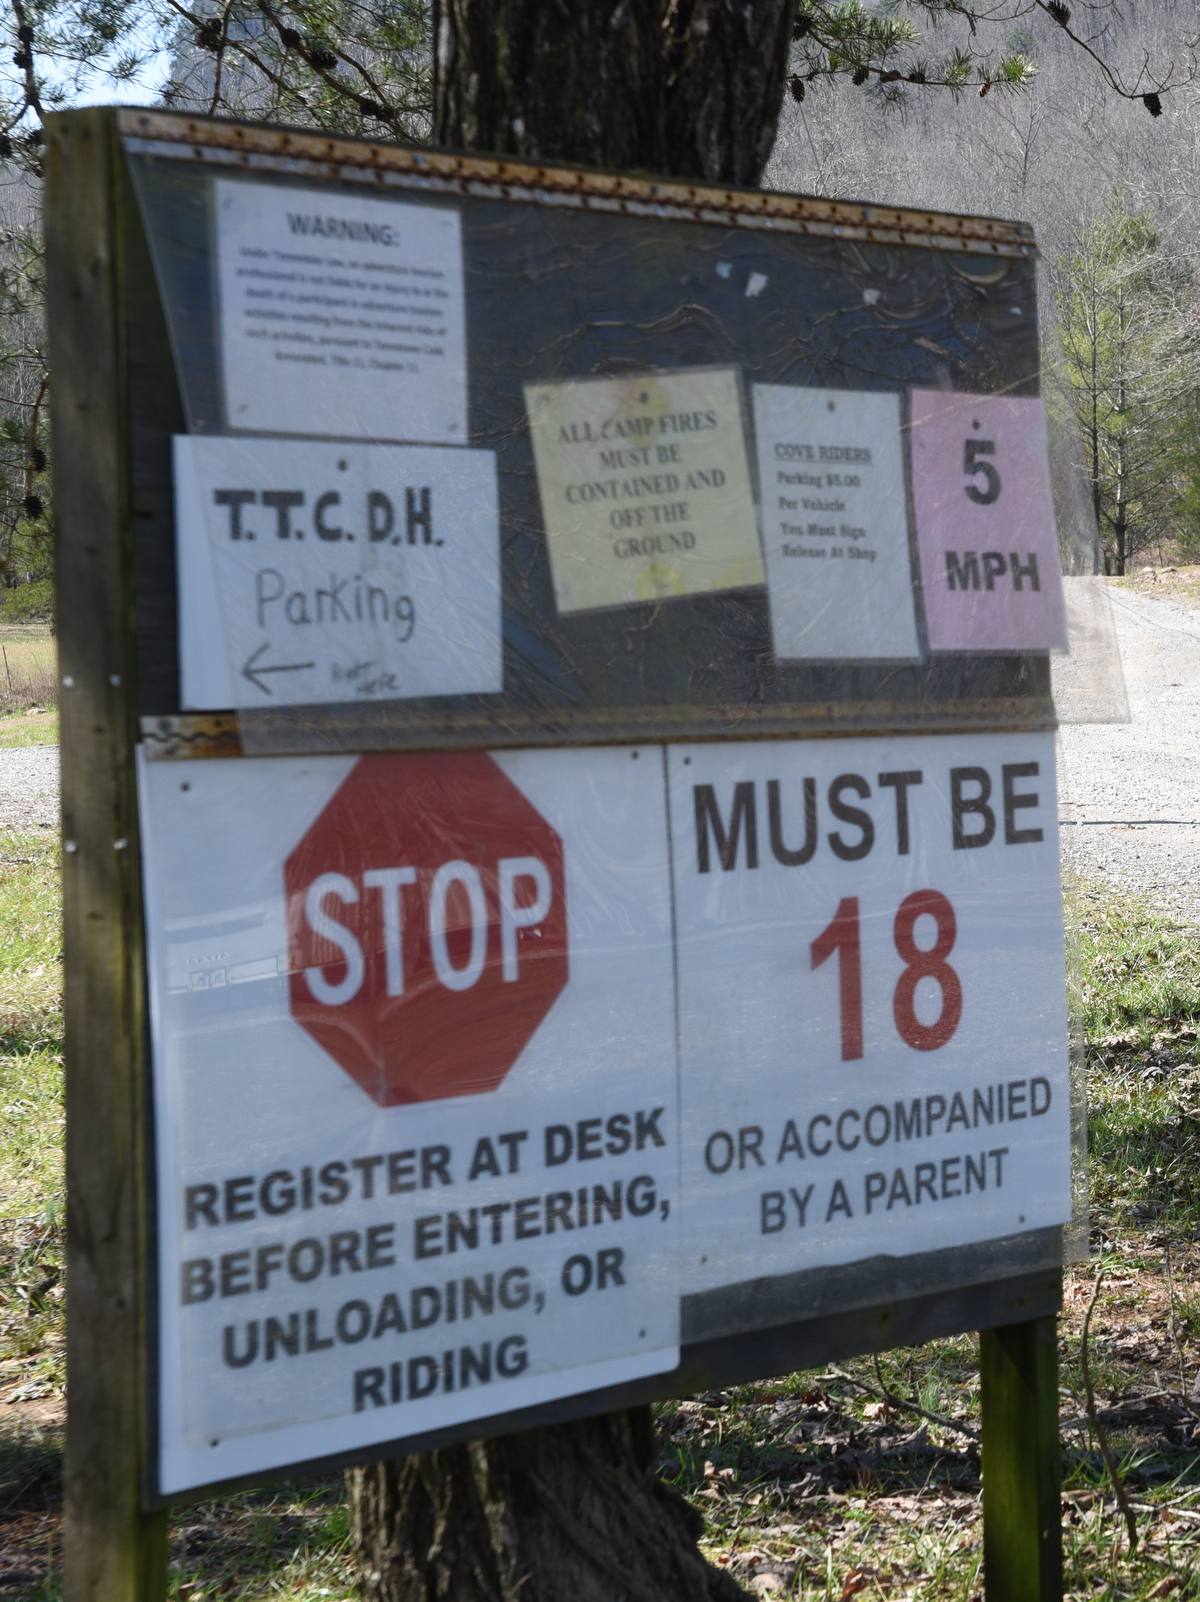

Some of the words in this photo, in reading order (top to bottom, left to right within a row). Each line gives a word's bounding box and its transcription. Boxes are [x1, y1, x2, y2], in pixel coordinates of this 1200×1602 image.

[286, 212, 401, 248] WARNING:
[557, 421, 598, 445] ALL
[600, 416, 654, 441] CAMP
[657, 409, 718, 436] FIRES
[599, 446, 652, 471] MUST
[656, 443, 682, 466] BE
[773, 442, 815, 459] COVE
[818, 445, 873, 462] RIDERS
[963, 438, 1002, 506] 5
[564, 473, 680, 504] CONTAINED
[685, 467, 726, 491] AND
[776, 470, 824, 489] Parking
[609, 506, 647, 530] OFF
[651, 500, 692, 524] THE
[778, 496, 799, 511] Per
[801, 497, 846, 512] Vehicle
[612, 530, 697, 561] GROUND
[779, 521, 805, 536] You
[807, 522, 837, 537] Must
[840, 524, 866, 541] Sign
[781, 543, 827, 558] Release
[830, 546, 845, 559] At
[847, 546, 878, 564] Shop
[944, 550, 1042, 592] MPH
[255, 568, 416, 643] Parking
[692, 769, 924, 874] MUST
[949, 761, 1045, 852] BE
[302, 855, 554, 1007] STOP
[809, 888, 963, 1062] 18
[704, 1125, 766, 1175] OR
[777, 1076, 1052, 1164] ACCOMPANIED
[184, 1144, 452, 1231] REGISTER
[467, 1130, 529, 1181] AT
[543, 1106, 668, 1168] DESK
[759, 1183, 816, 1235] BY
[824, 1178, 854, 1223] A
[864, 1146, 1010, 1216] PARENT
[181, 1222, 397, 1306] BEFORE
[413, 1174, 671, 1261] ENTERING,
[221, 1265, 546, 1369] UNLOADING,
[560, 1246, 627, 1298] OR
[352, 1333, 531, 1414] RIDING
